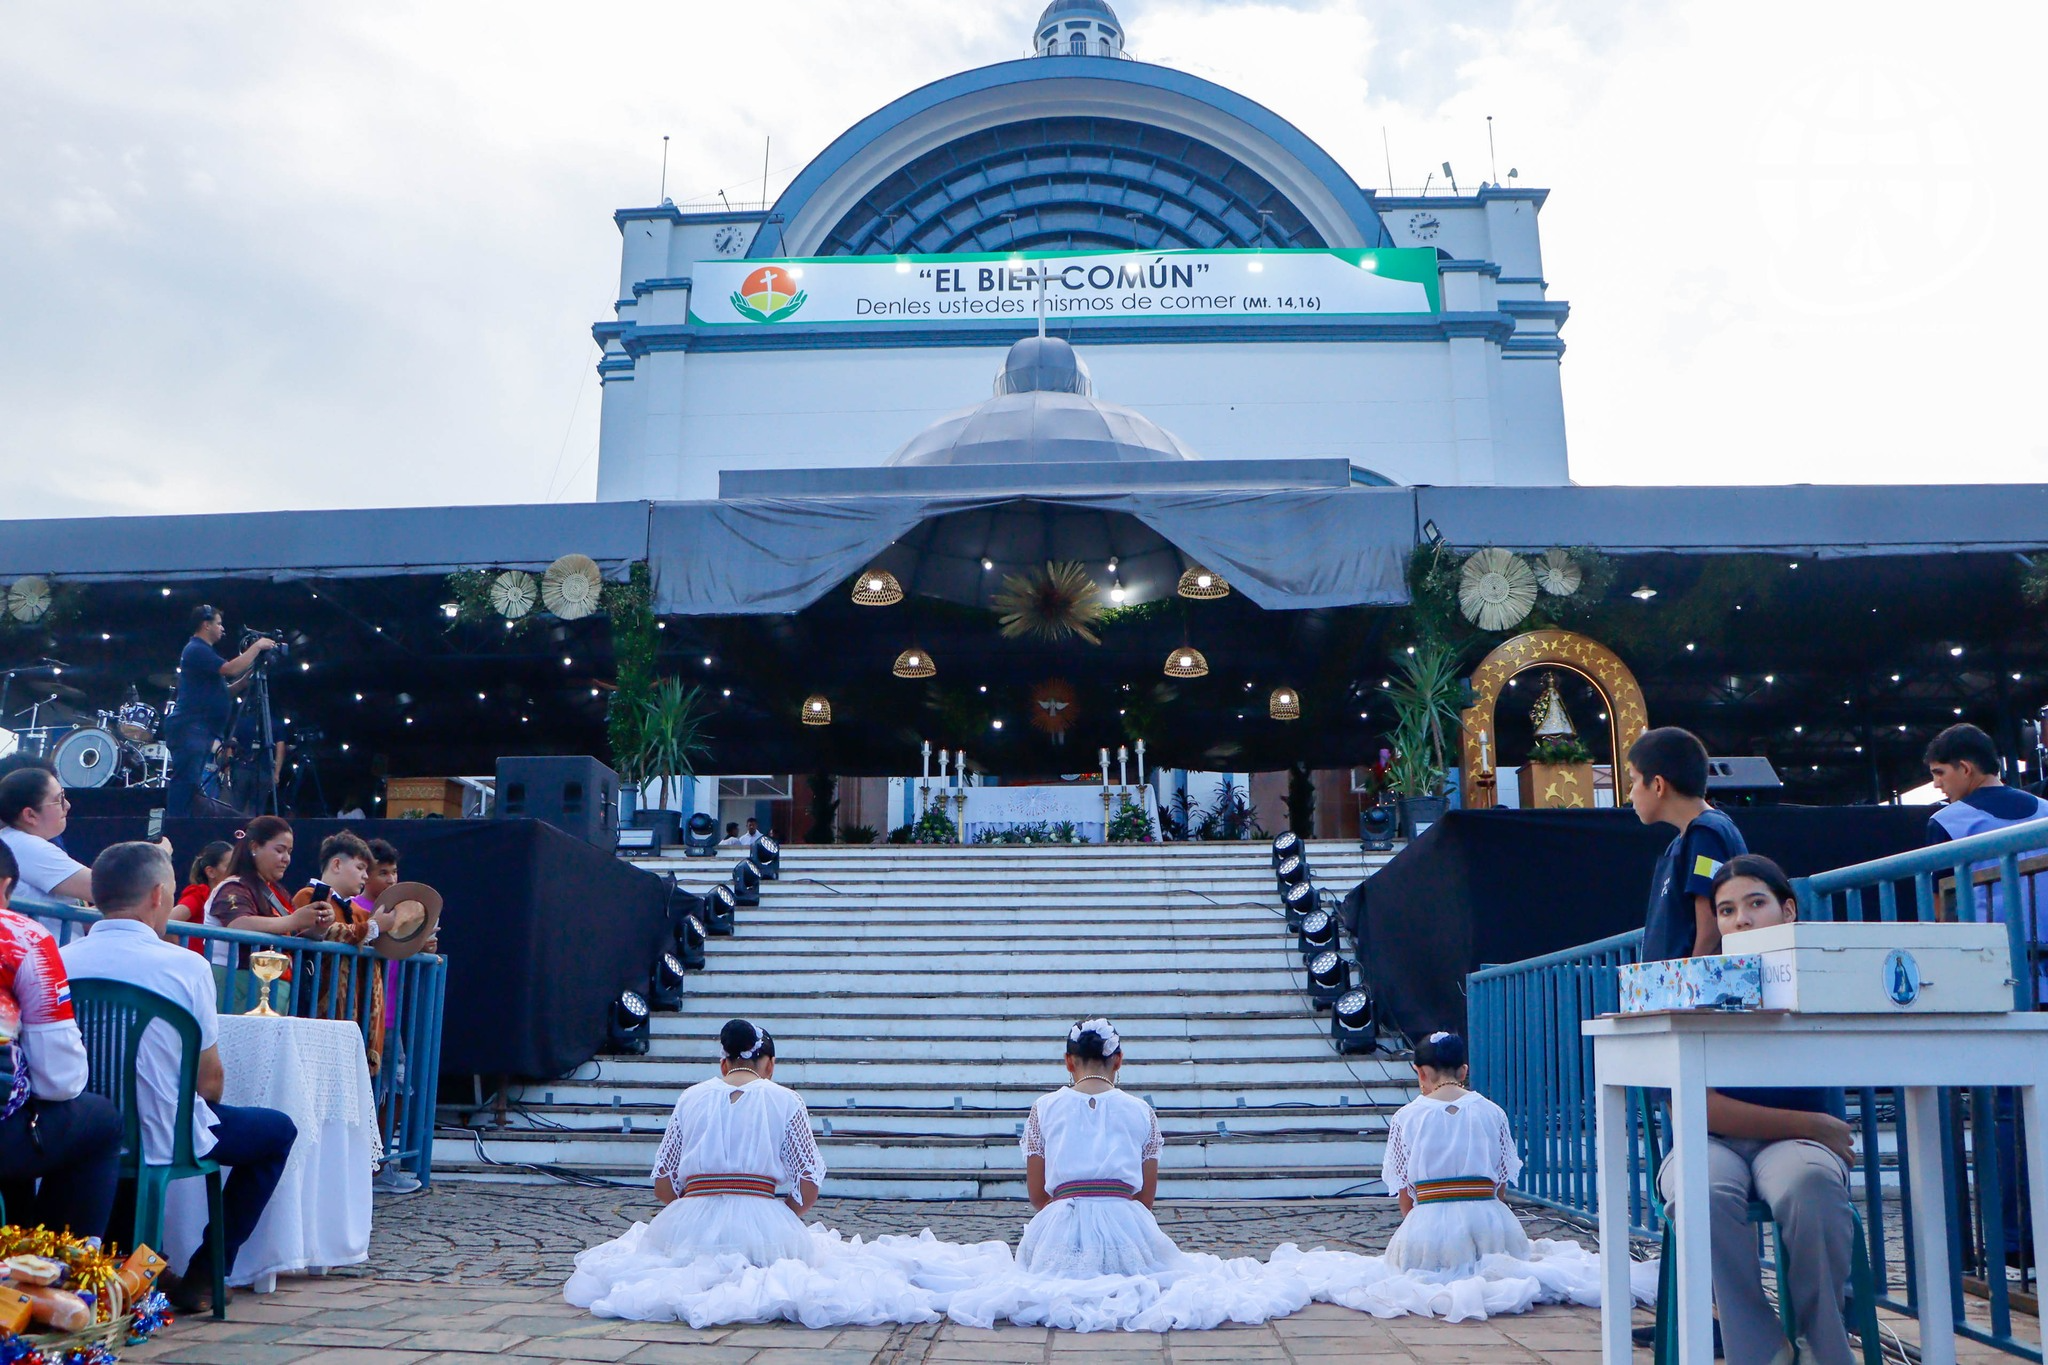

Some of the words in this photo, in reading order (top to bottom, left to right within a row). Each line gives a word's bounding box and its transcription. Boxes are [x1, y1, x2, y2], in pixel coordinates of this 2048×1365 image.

[978, 266, 1047, 292] BIEN
[856, 298, 931, 315] Denles
[938, 296, 1025, 314] ustedes
[1121, 293, 1152, 310] de
[1160, 295, 1236, 310] comer
[1243, 296, 1271, 311] (Mt.
[1277, 296, 1321, 311] 14,16)
